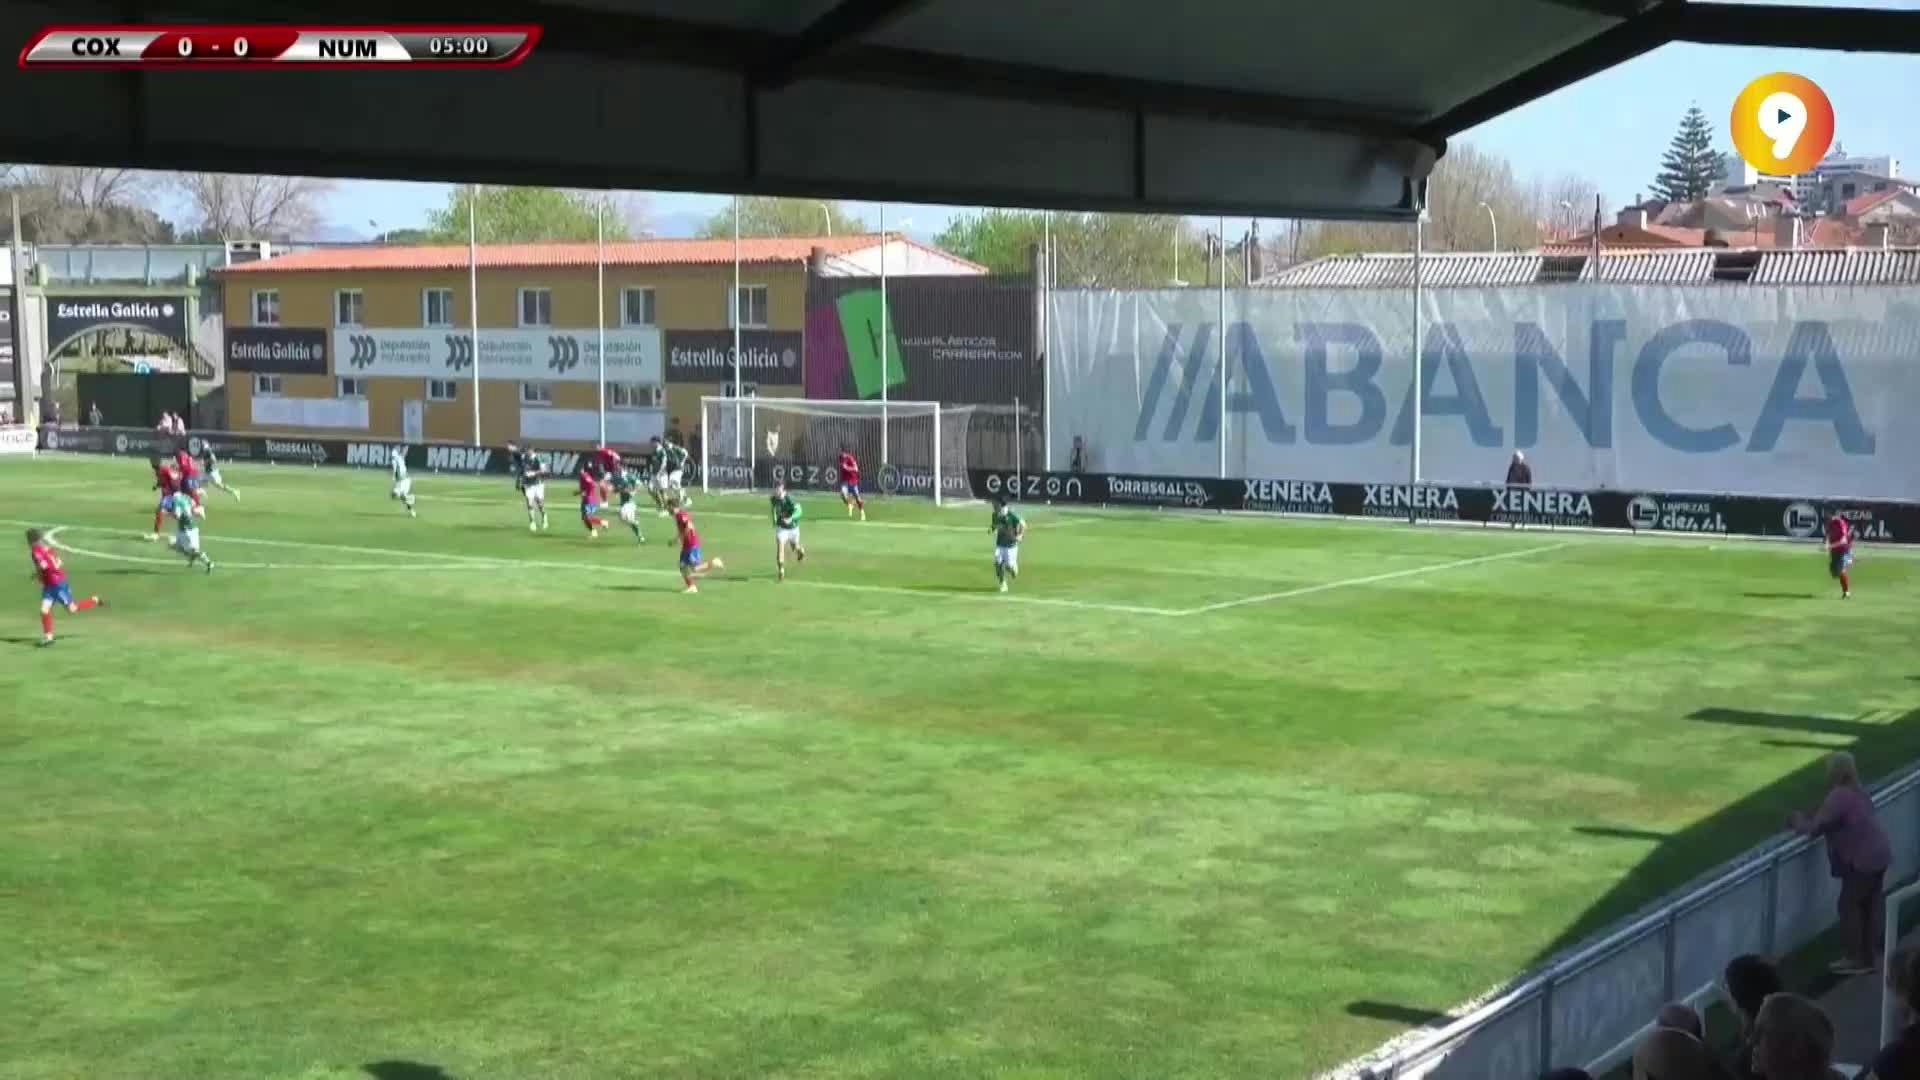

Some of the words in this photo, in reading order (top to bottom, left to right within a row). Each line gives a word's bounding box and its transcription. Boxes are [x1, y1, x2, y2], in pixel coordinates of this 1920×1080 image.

[57, 303, 109, 317] Estrella
[111, 303, 160, 317] Galicia
[231, 341, 271, 360] Estrella
[272, 340, 311, 360] Galicia
[671, 346, 724, 367] Estrella
[427, 447, 491, 469] MRW
[538, 451, 579, 474] RW
[902, 474, 963, 489] maran
[1243, 479, 1334, 503] XENERA
[1363, 485, 1460, 509] XENERA
[1491, 489, 1593, 516] XENERA
